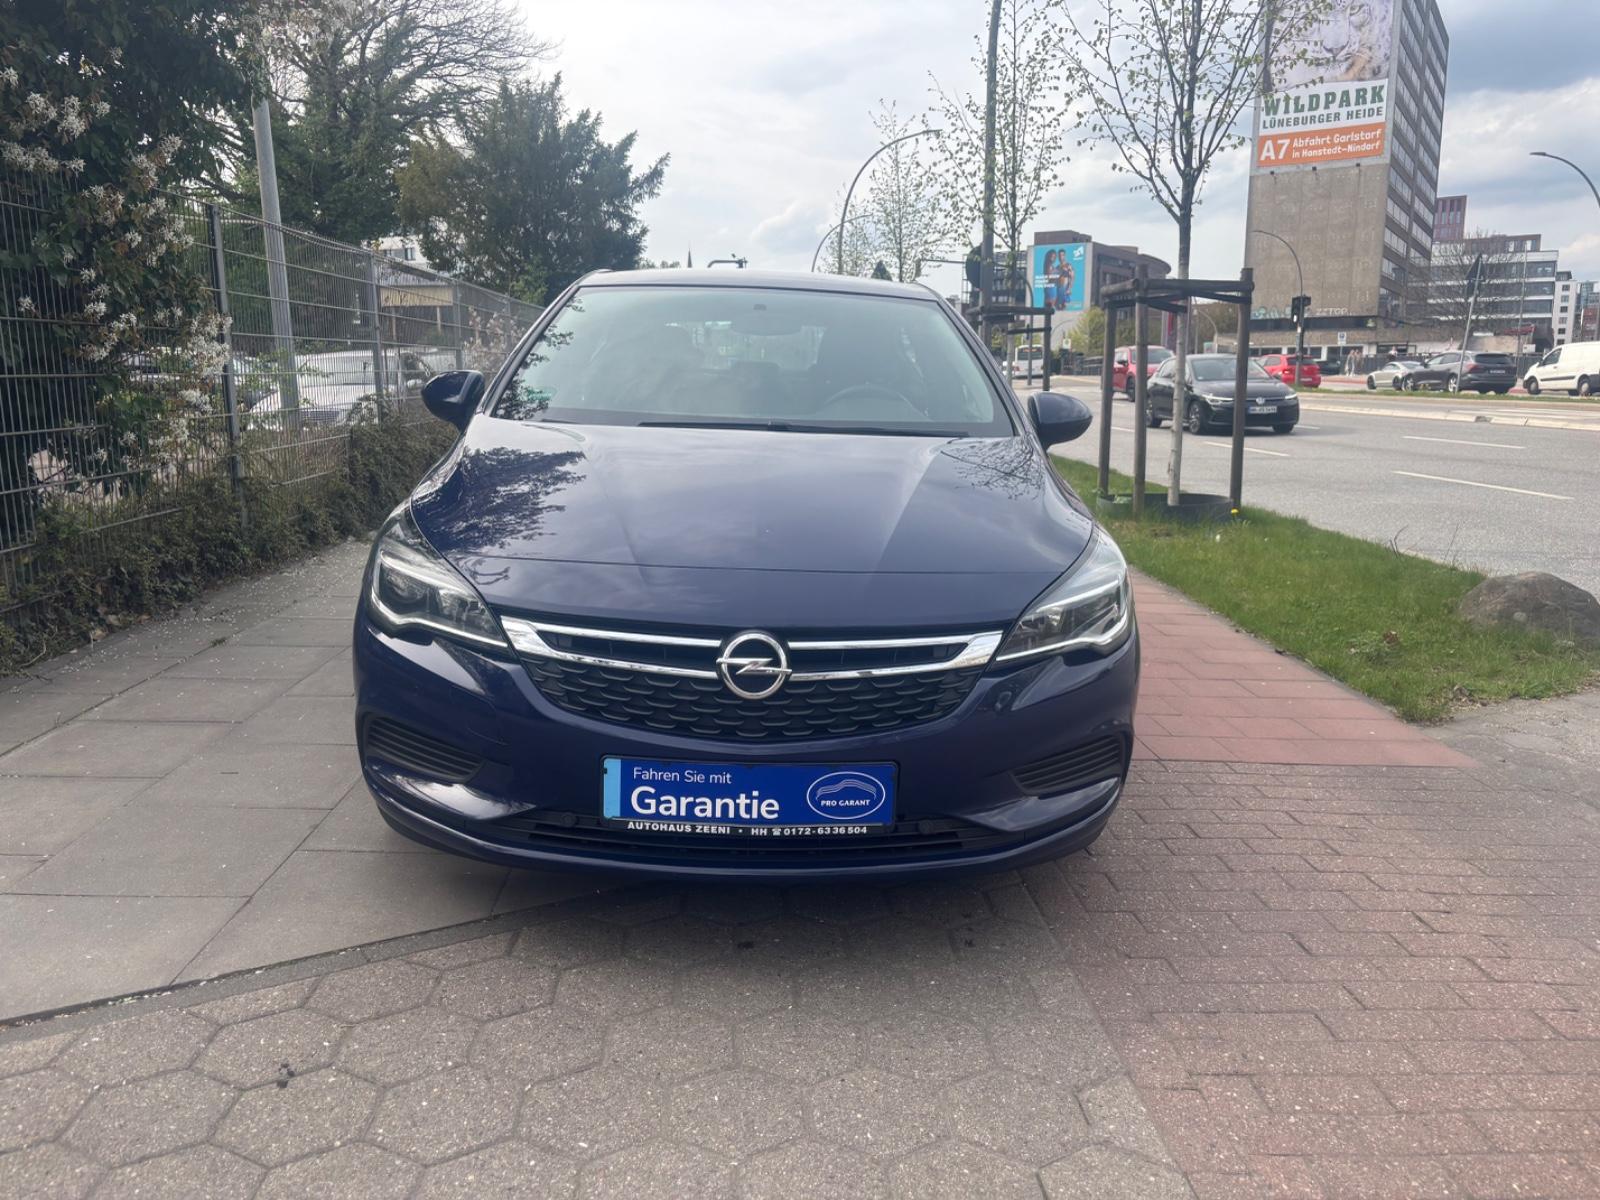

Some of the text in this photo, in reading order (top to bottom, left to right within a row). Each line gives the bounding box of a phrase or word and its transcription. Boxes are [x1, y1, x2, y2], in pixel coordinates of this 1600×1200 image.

[1263, 85, 1385, 116] WILDPARK
[1262, 106, 1383, 129] LÜNEBURGER HEIDE
[1260, 139, 1290, 160] A7
[1292, 137, 1331, 147] Abfahrt
[1292, 149, 1300, 158] in
[633, 767, 732, 784] Fahren Sie mit
[630, 786, 780, 819] Garantie
[627, 821, 692, 832] AUTOHAUS
[695, 825, 731, 834] ZEENI
[751, 828, 767, 836] HH
